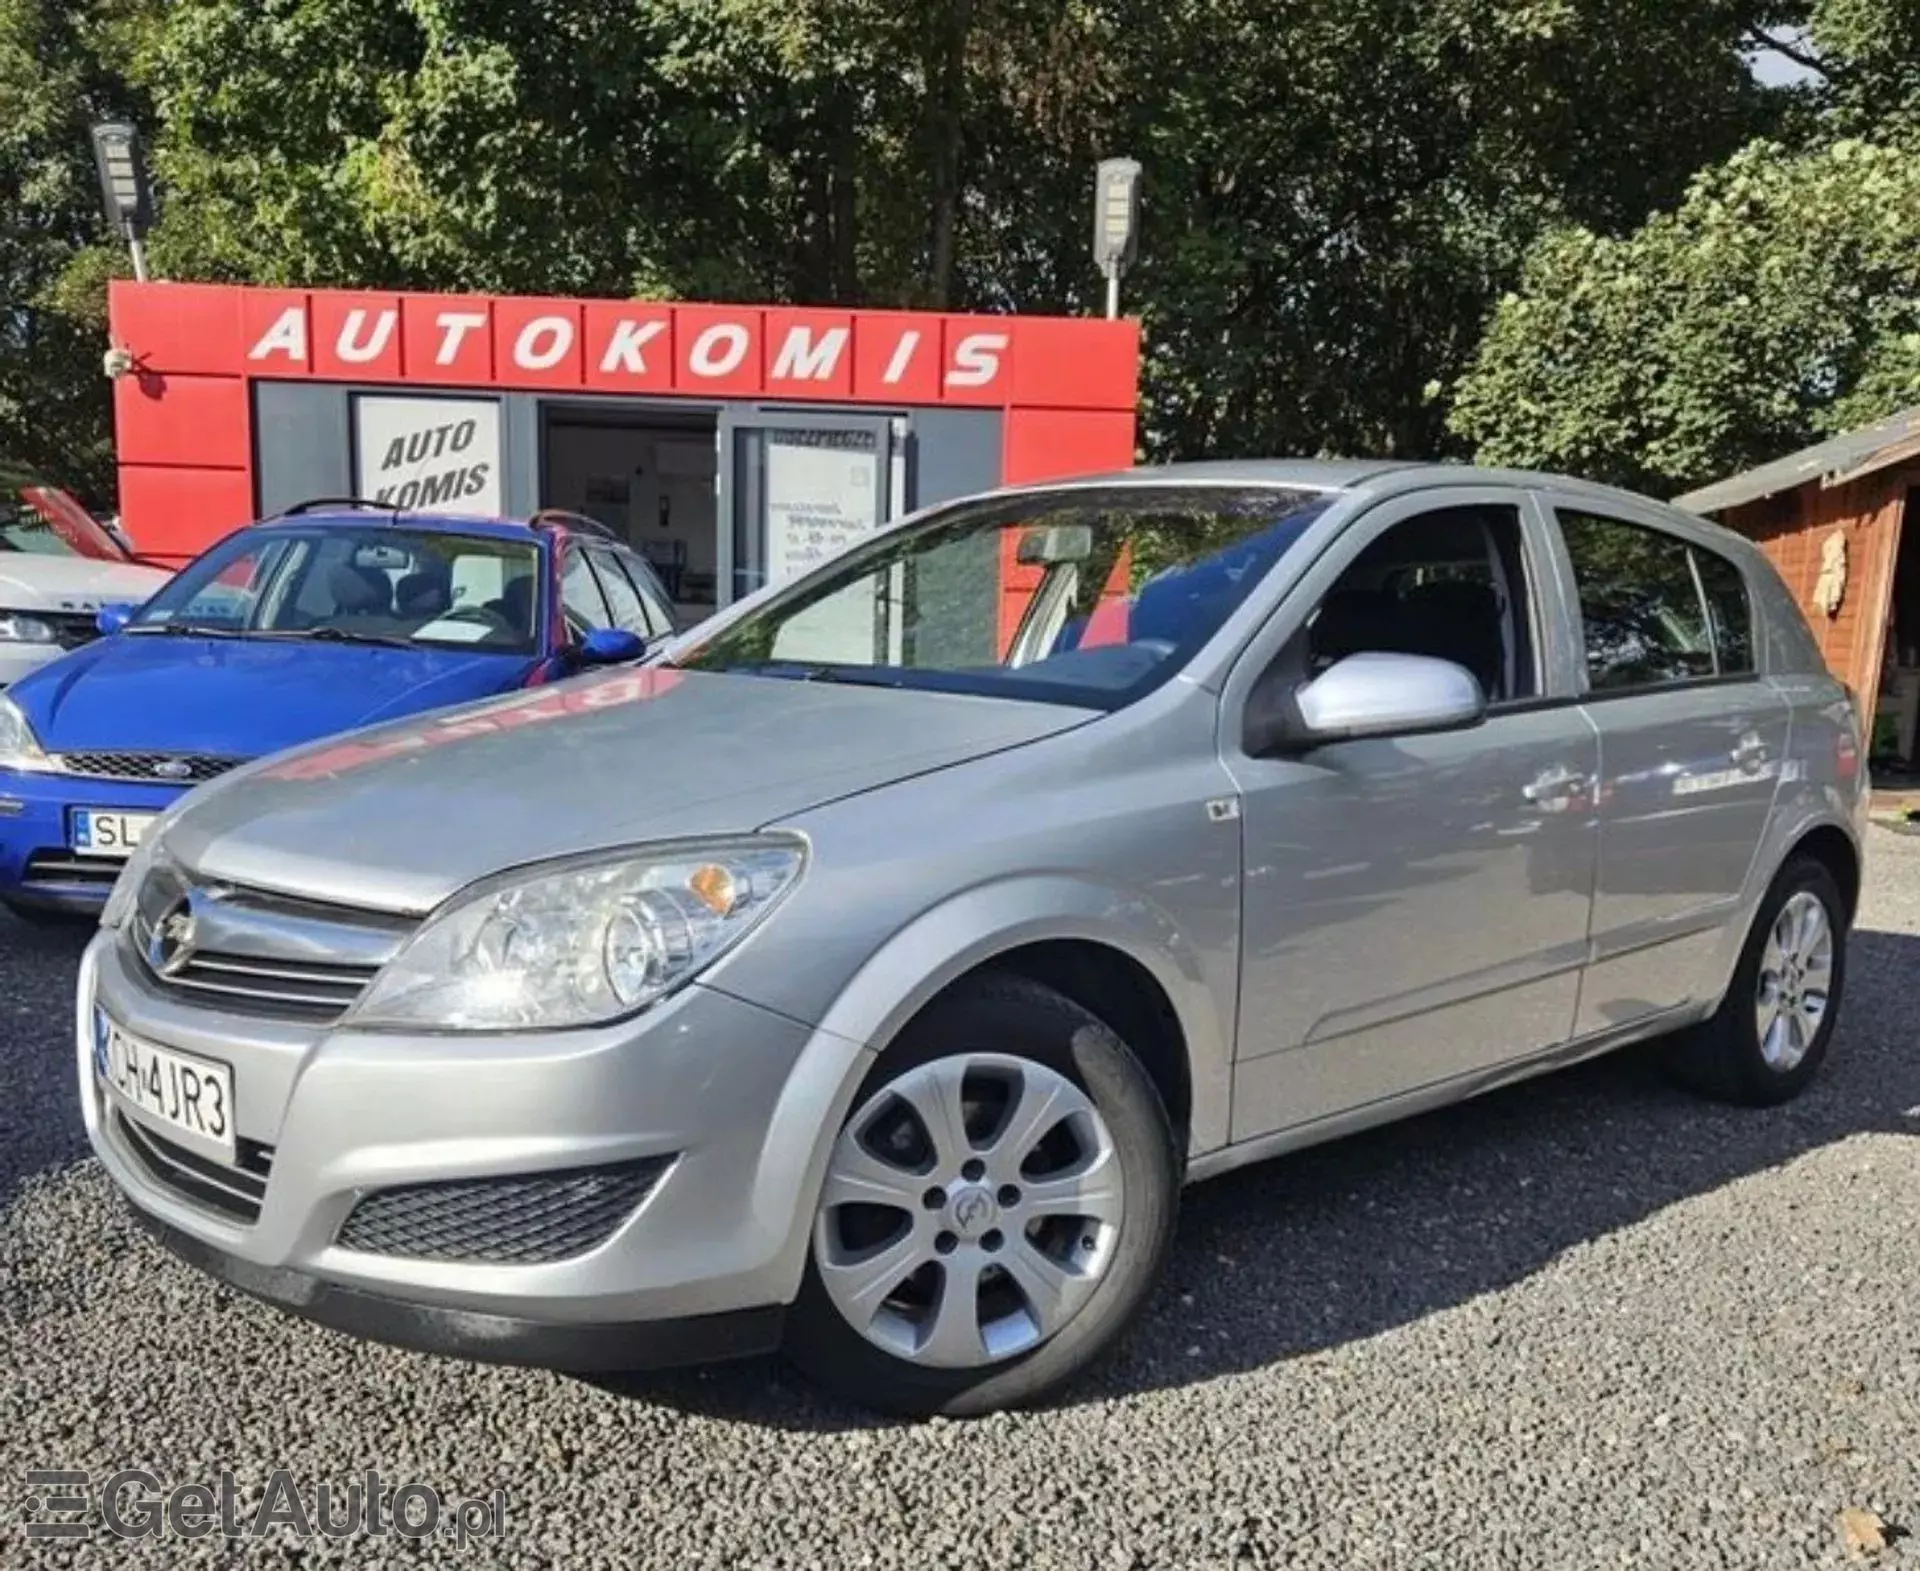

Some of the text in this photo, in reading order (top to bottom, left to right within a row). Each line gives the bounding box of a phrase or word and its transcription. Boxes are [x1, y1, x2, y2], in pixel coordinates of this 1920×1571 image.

[248, 306, 1010, 387] AUTOKOMIS
[381, 418, 477, 471] AUTO
[375, 462, 490, 511] KOMIS
